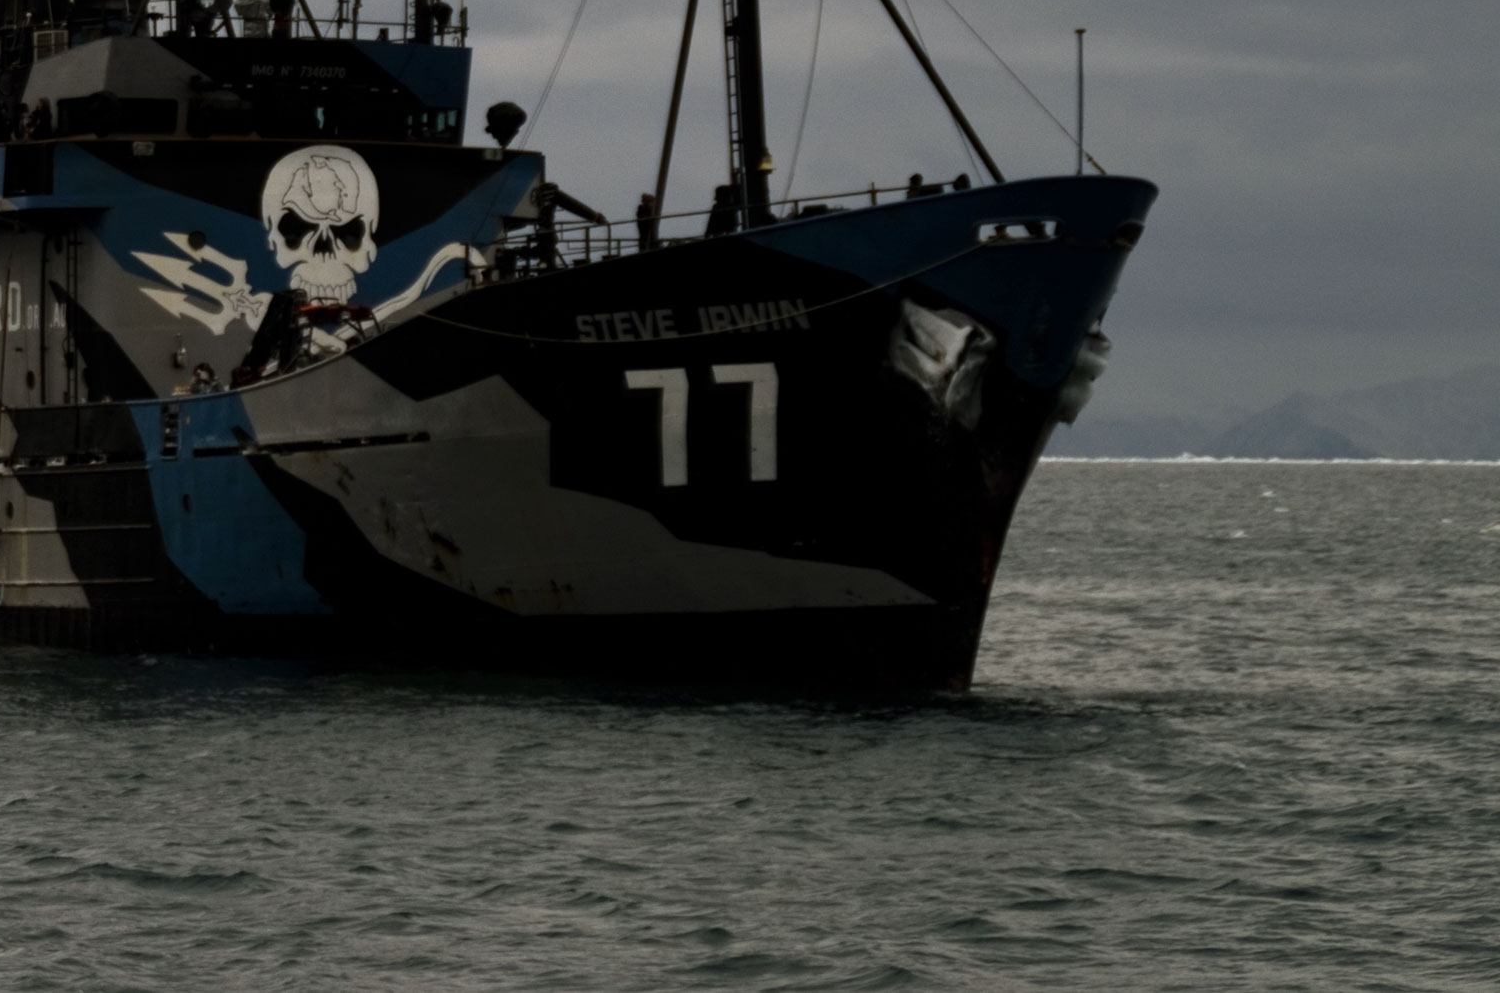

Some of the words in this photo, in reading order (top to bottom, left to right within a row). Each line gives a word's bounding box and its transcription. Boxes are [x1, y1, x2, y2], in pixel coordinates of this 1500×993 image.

[251, 64, 275, 77] IMO
[299, 66, 347, 79] 7340370
[575, 308, 679, 343] STEVE
[697, 298, 812, 335] IRWIN
[624, 362, 779, 487] 77
